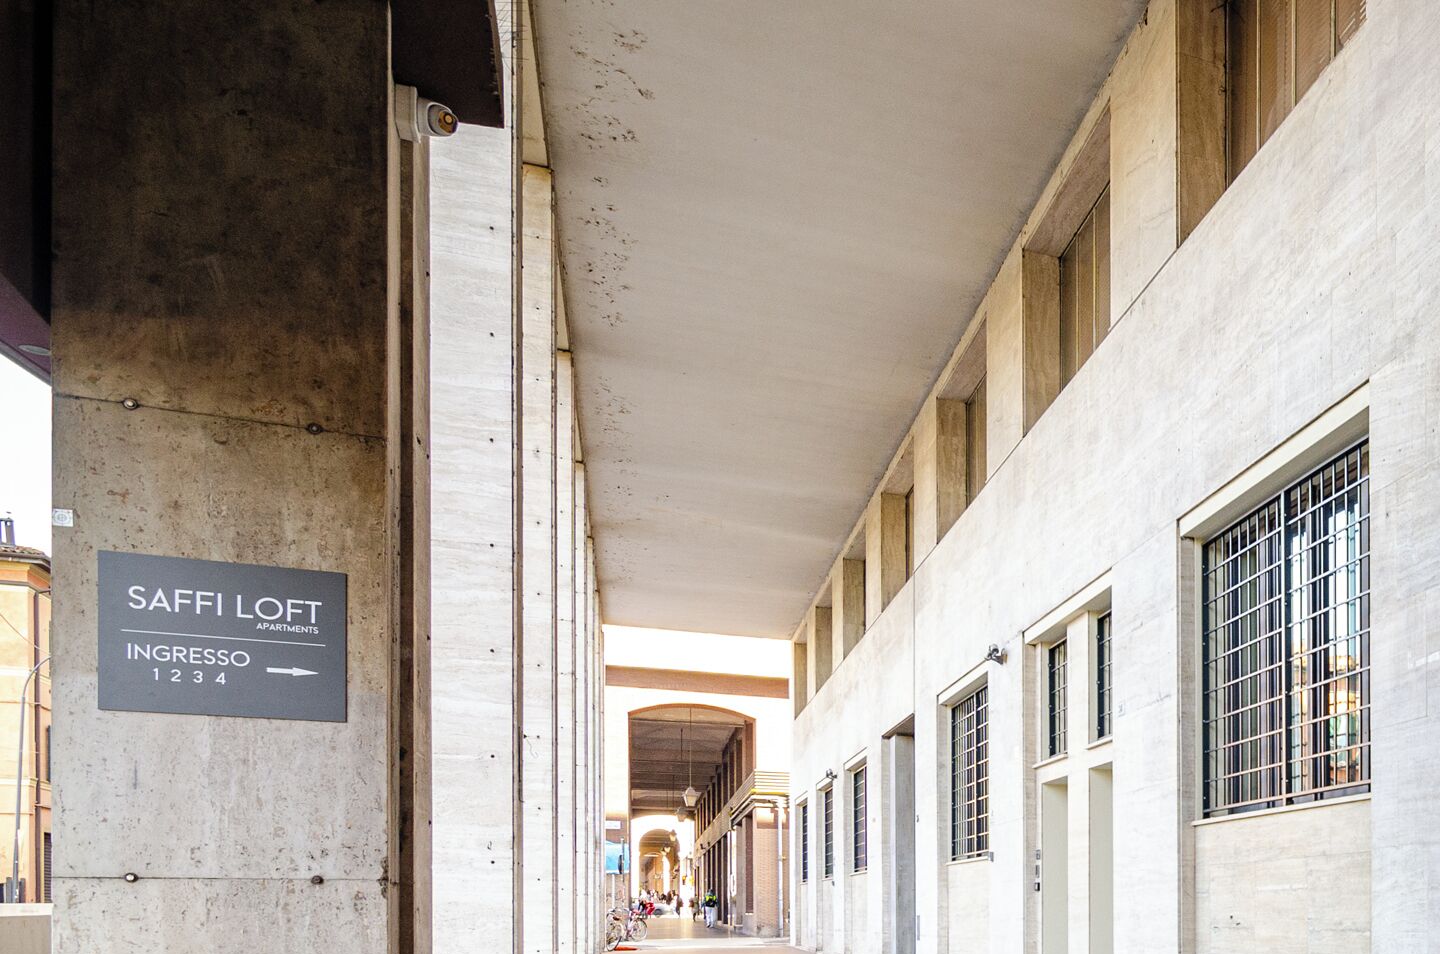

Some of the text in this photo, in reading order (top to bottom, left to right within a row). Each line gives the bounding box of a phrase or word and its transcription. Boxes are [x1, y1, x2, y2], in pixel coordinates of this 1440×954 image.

[128, 585, 322, 624] SAFFI LOFT
[256, 622, 319, 635] APARTMENTS
[127, 642, 250, 667] INGRESSO
[152, 667, 227, 685] 1 2 3 4
